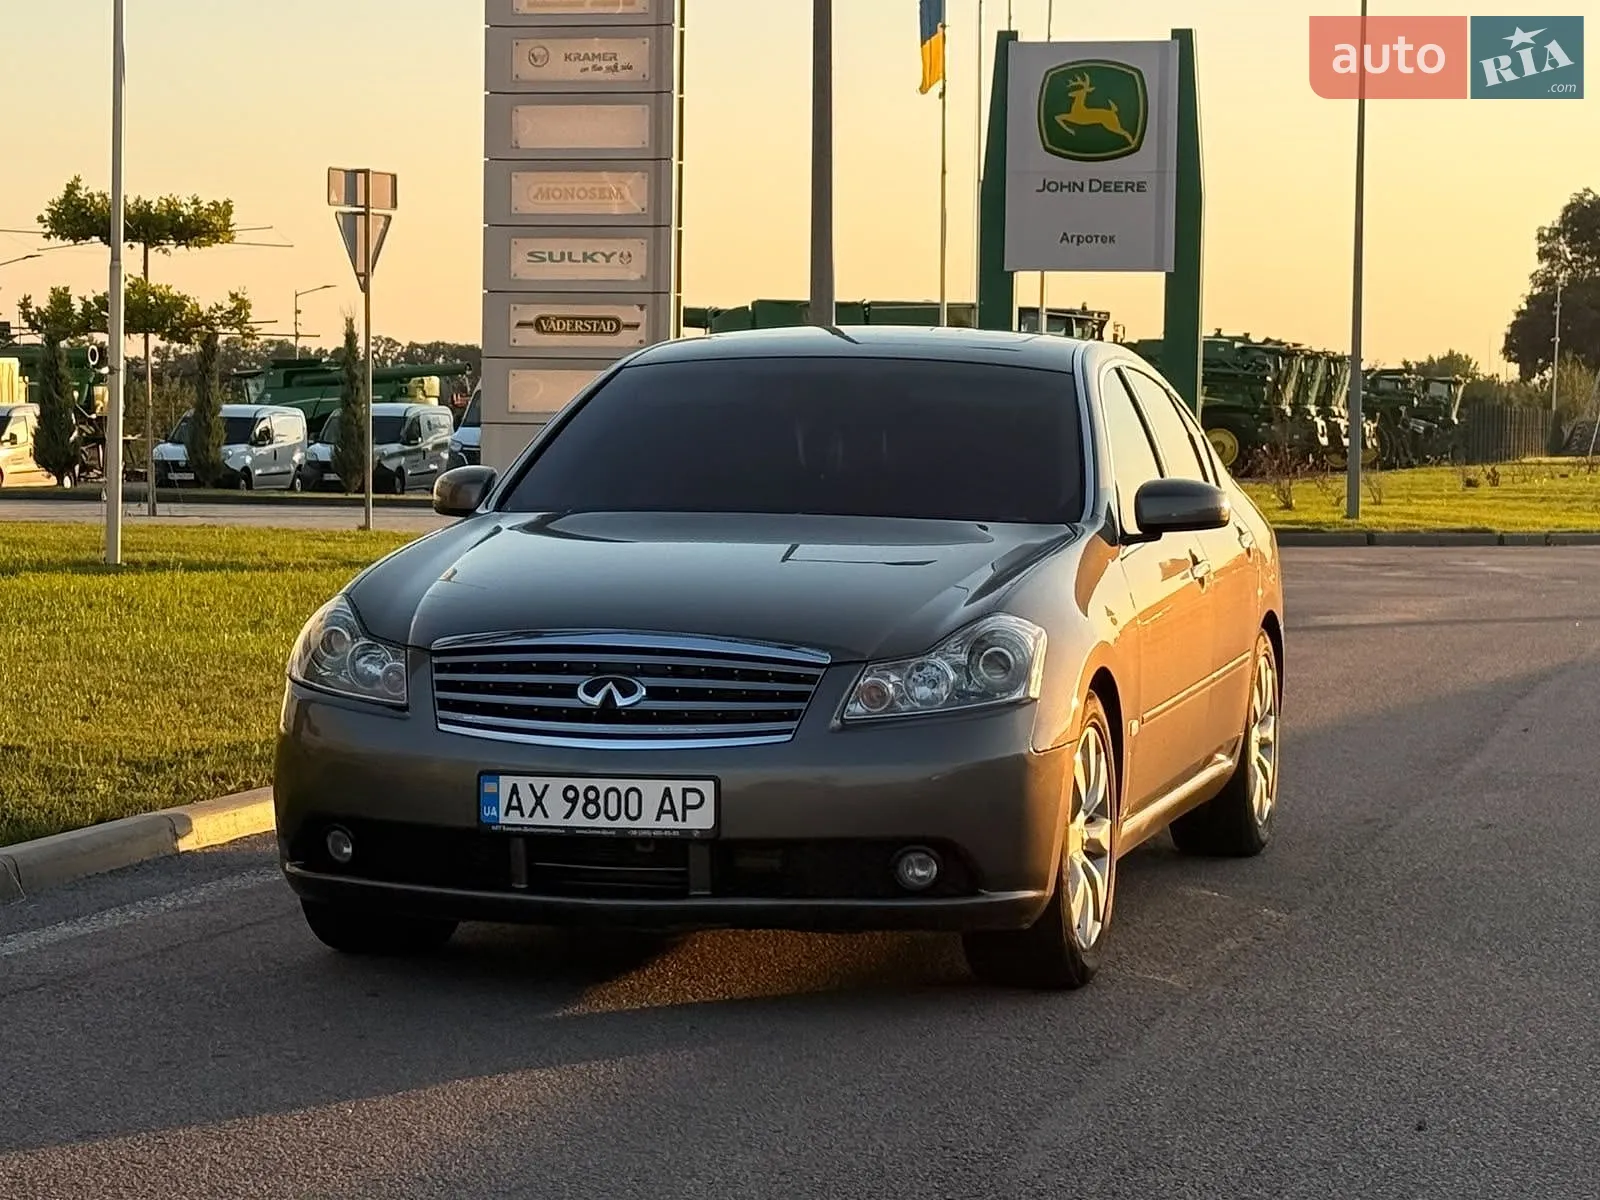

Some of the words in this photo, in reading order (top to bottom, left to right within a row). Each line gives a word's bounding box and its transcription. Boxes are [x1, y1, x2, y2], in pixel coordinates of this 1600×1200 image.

[564, 52, 618, 62] KRAMER
[1036, 178, 1085, 193] JOHN
[1088, 178, 1147, 193] DEERE
[533, 186, 626, 201] MONOSEM
[1059, 232, 1116, 246] Агротек
[527, 251, 618, 263] SULKY
[540, 316, 618, 333] VÄDERSTAD
[504, 783, 550, 819] AX
[562, 784, 643, 821] 9800
[655, 786, 706, 823] AP
[483, 806, 498, 817] UA
